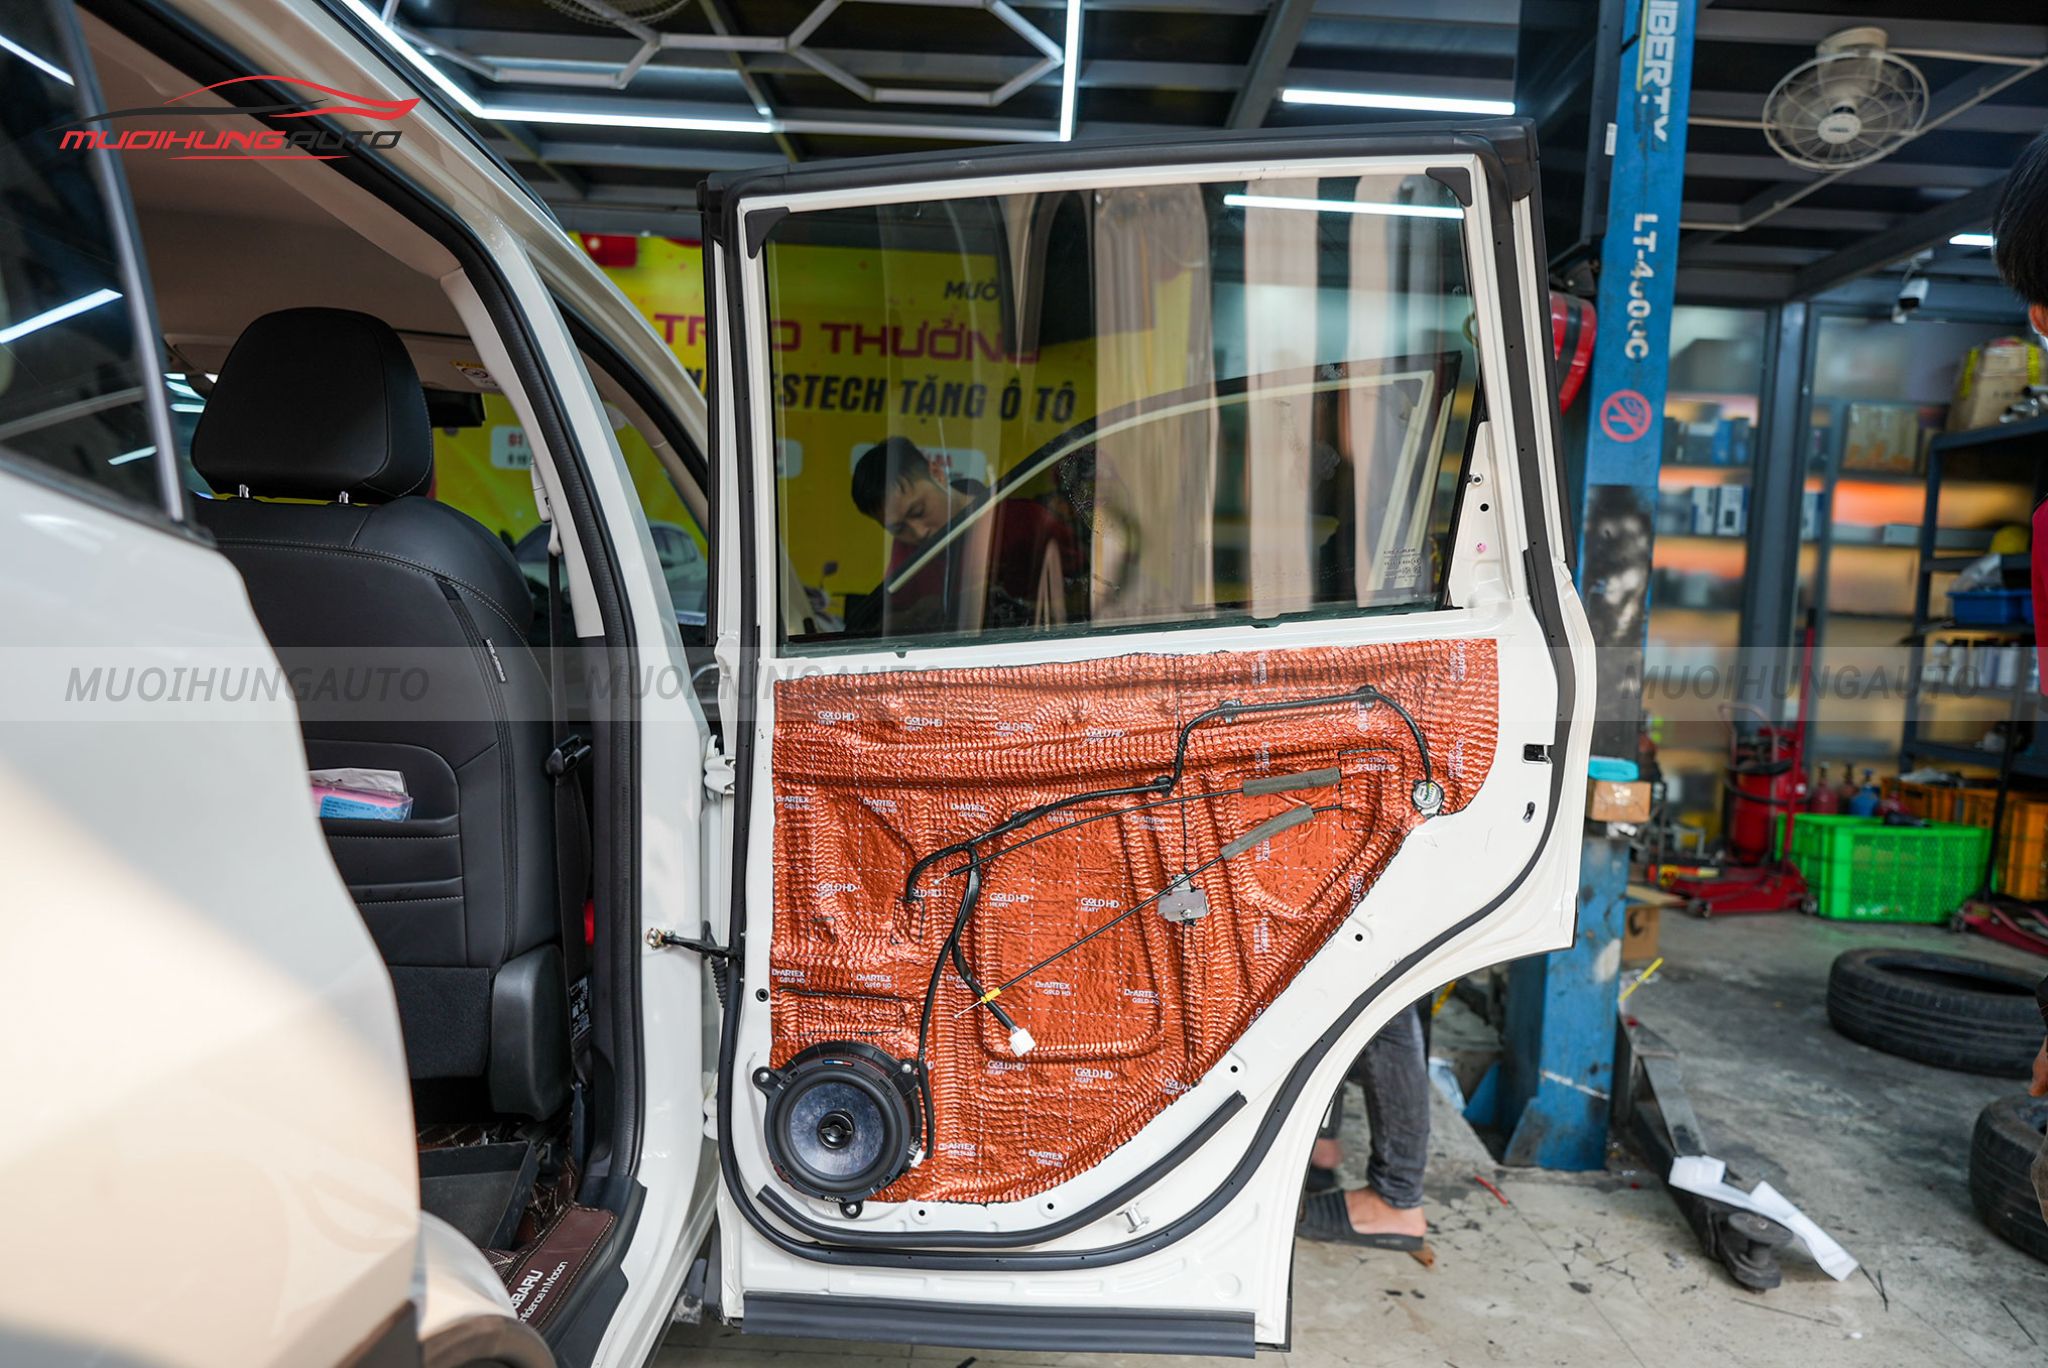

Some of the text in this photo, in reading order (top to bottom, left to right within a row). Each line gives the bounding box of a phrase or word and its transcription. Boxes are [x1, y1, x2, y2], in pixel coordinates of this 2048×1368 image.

[1641, 0, 1679, 142] IBERTY
[654, 313, 803, 351] TRO
[773, 372, 887, 413] STECH
[1035, 381, 1076, 424] TÔ
[989, 893, 1014, 903] GOLD
[1081, 897, 1119, 909] GOLD HD
[1076, 1067, 1113, 1079] GOLD HD
[511, 1269, 543, 1309] UBARU
